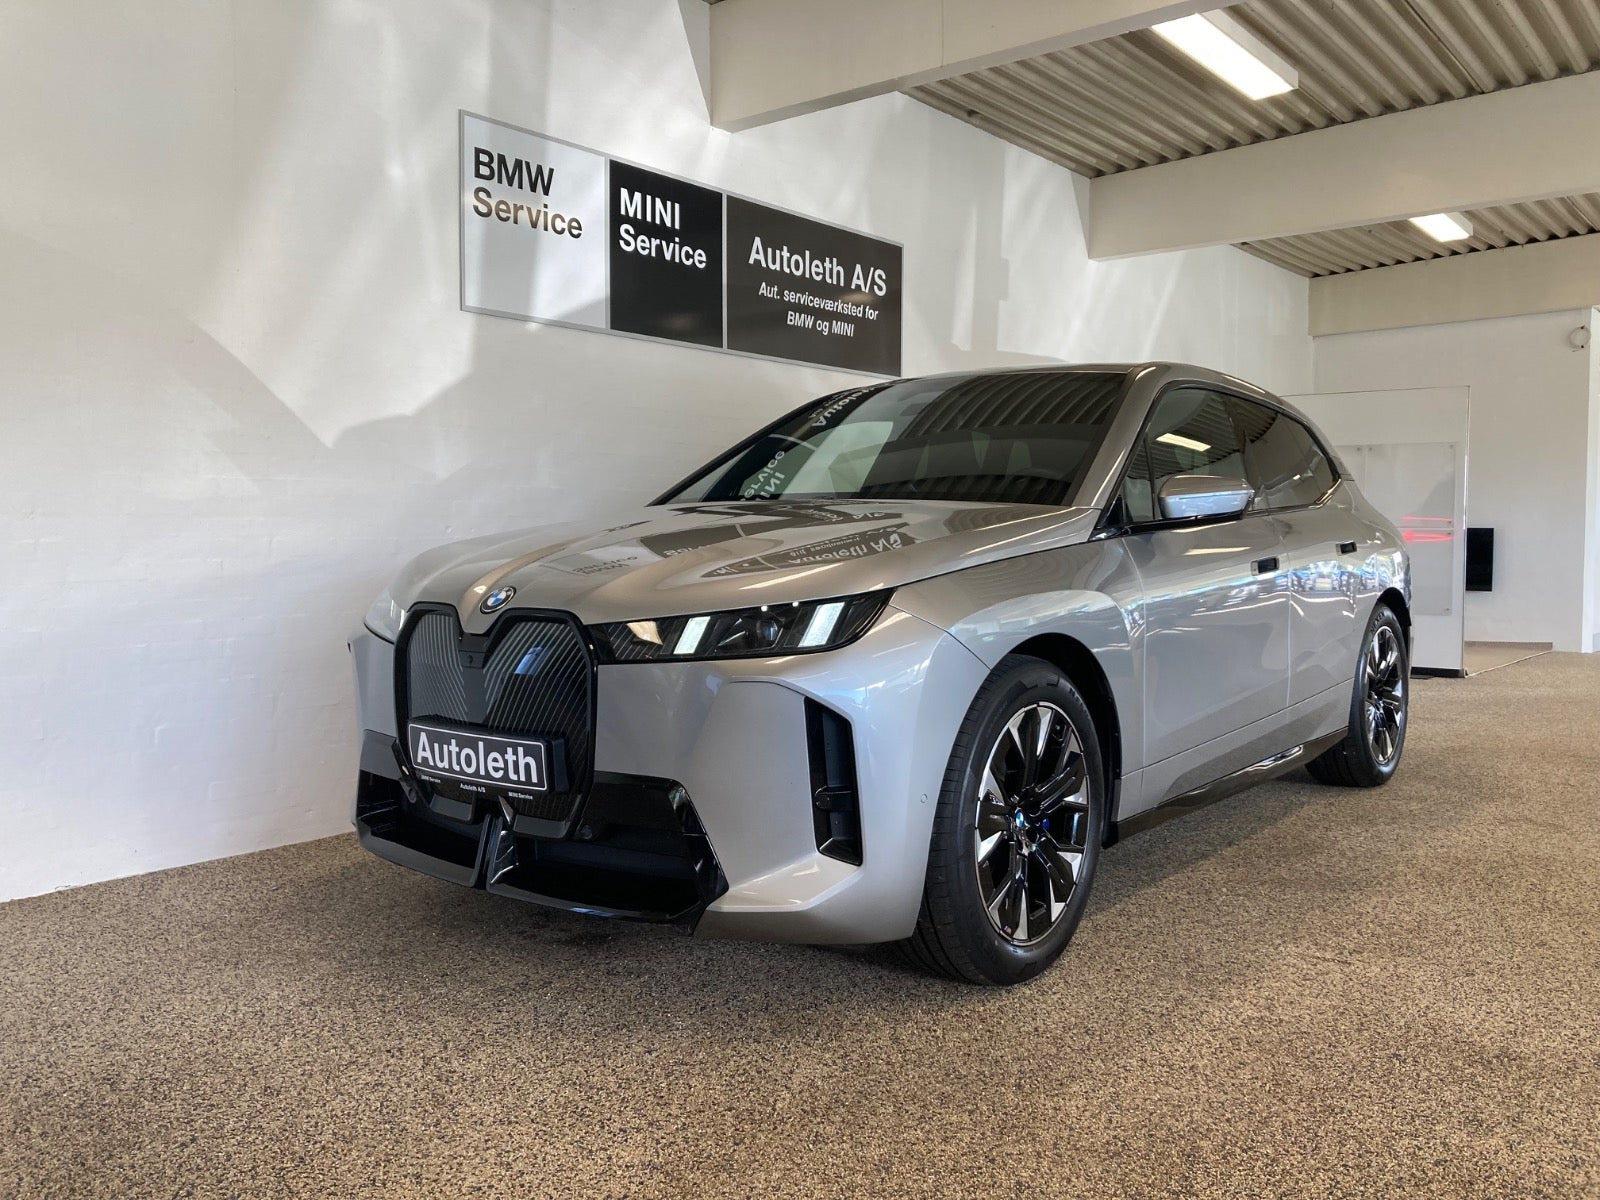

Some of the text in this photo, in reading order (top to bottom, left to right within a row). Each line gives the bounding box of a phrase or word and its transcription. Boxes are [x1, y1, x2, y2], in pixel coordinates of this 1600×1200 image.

[473, 147, 555, 197] BMW
[472, 186, 583, 239] Service
[619, 187, 681, 230] MINI
[618, 223, 708, 269] Service
[748, 236, 887, 297] Autoleth A/S
[758, 281, 879, 321] Aut. serviceværksted for
[786, 310, 855, 337] BMW og MINI
[417, 731, 538, 783] Autoleth
